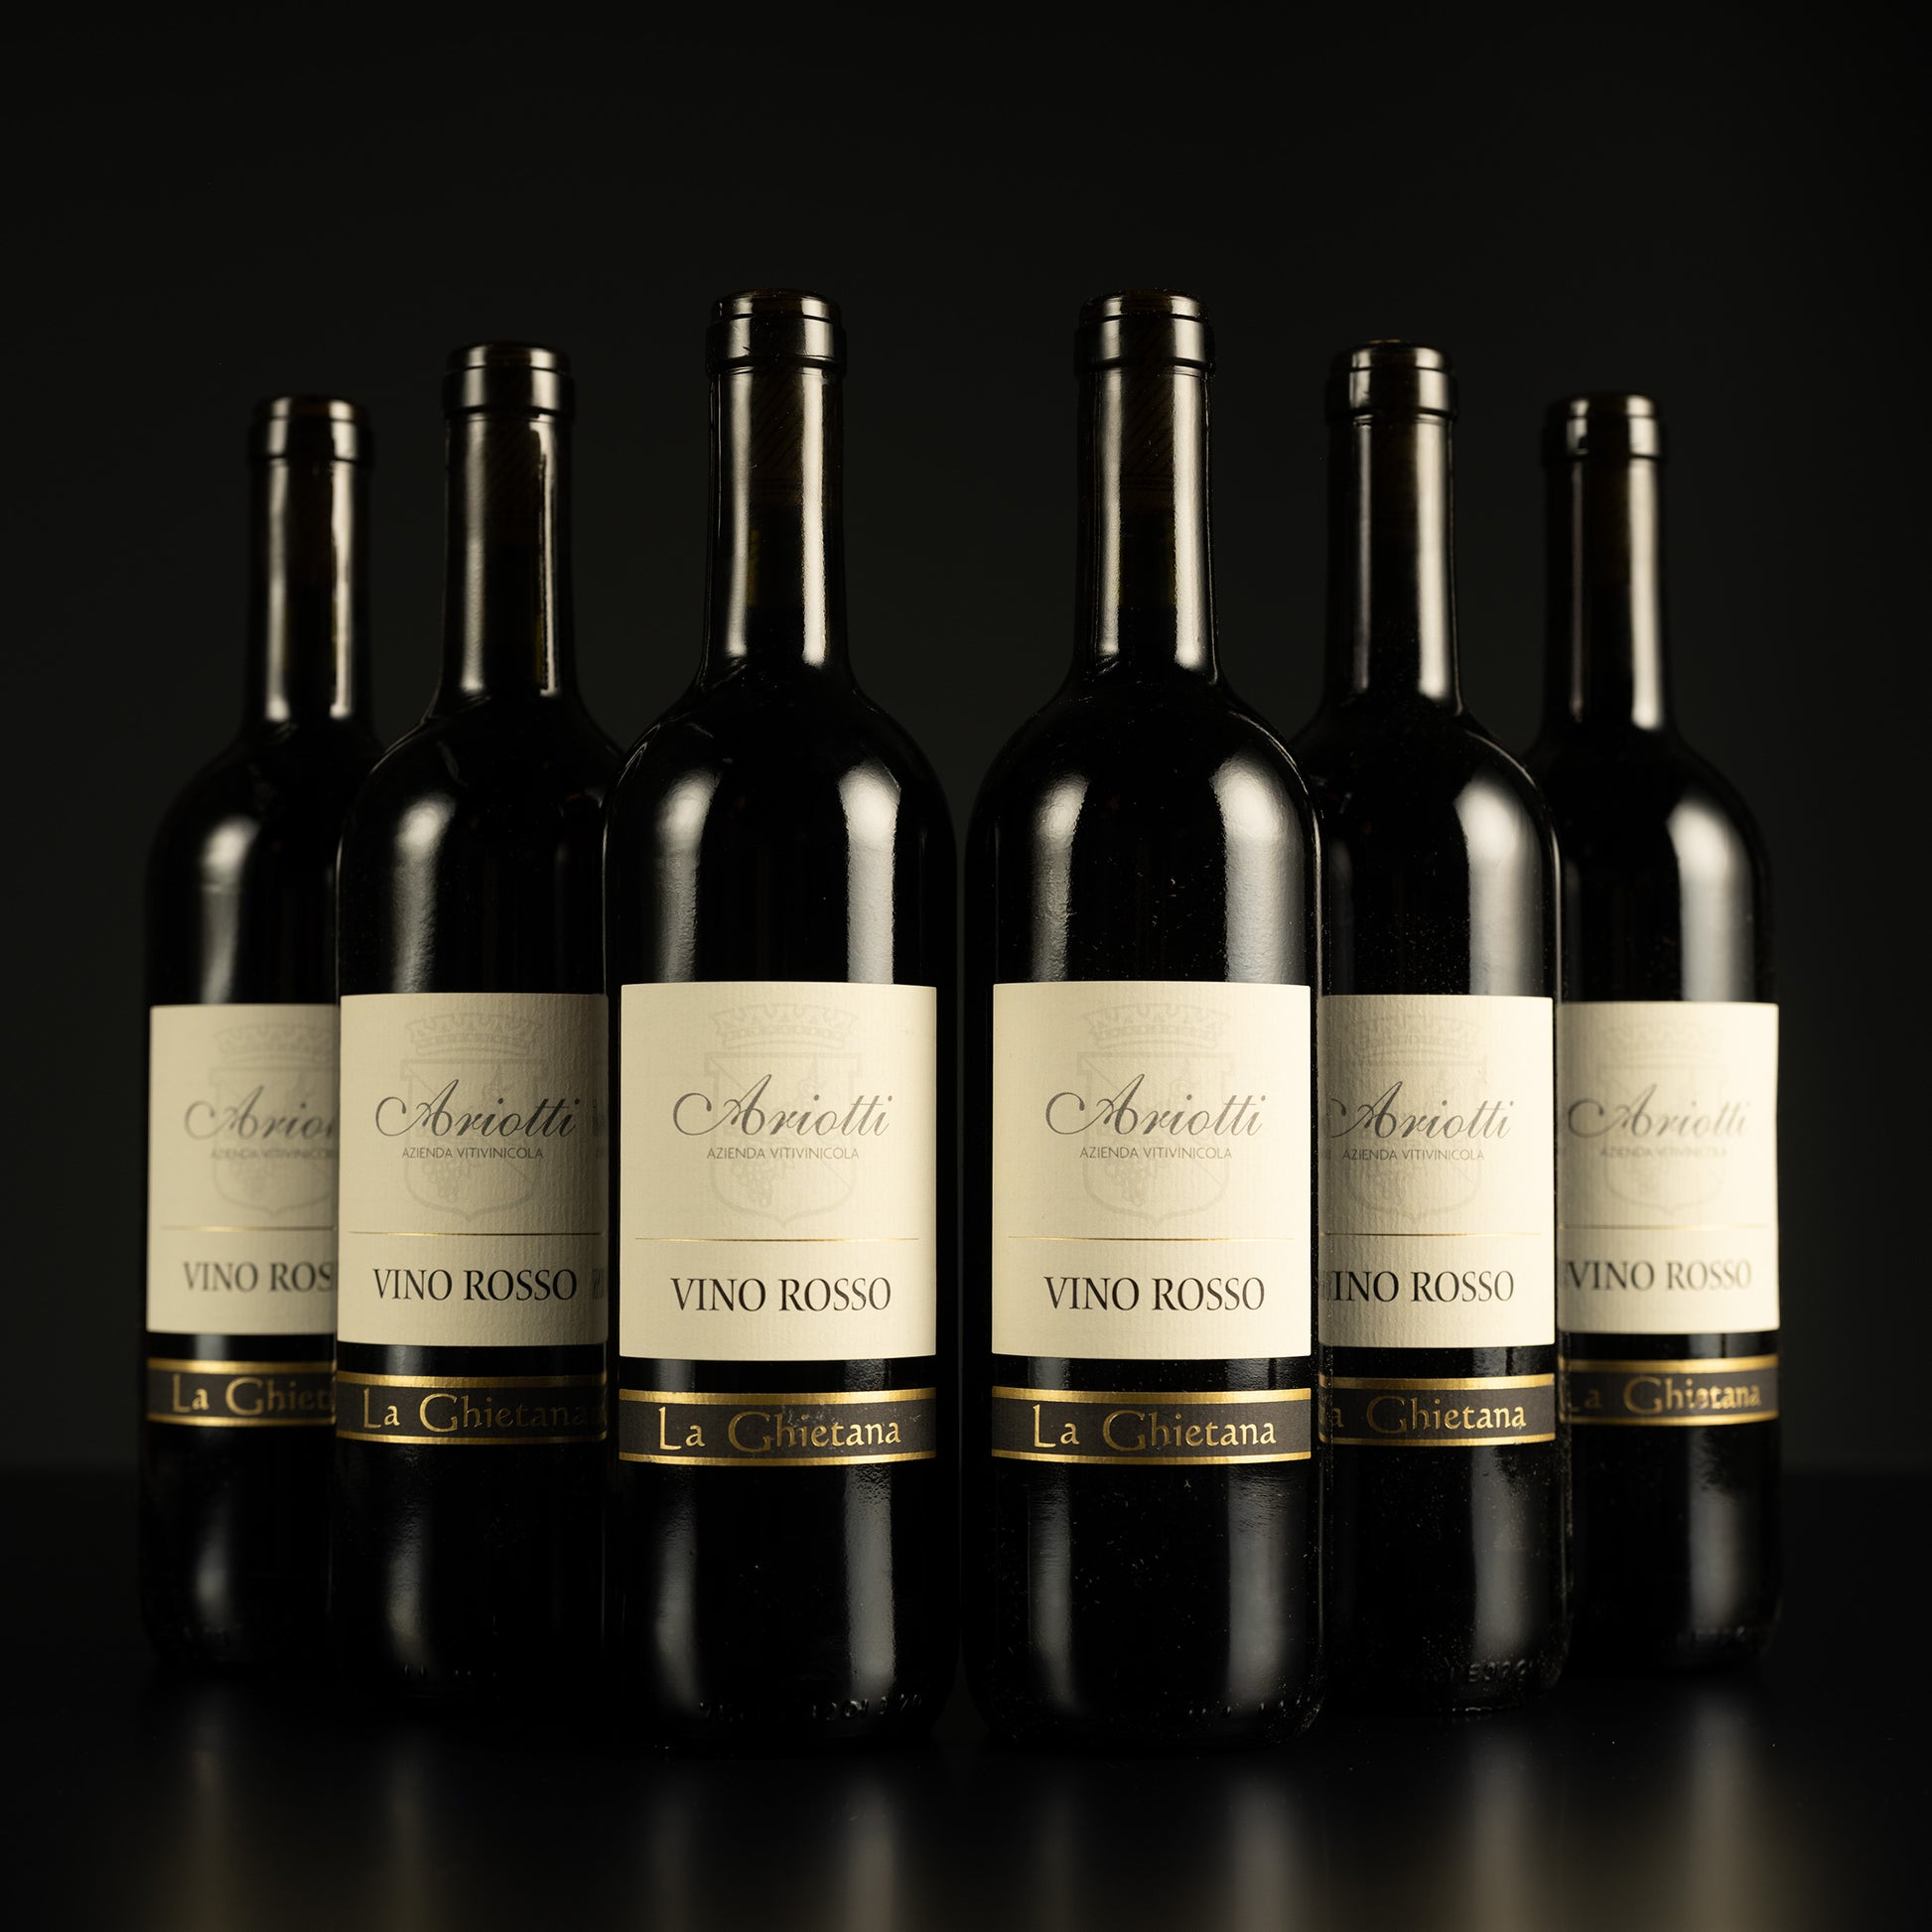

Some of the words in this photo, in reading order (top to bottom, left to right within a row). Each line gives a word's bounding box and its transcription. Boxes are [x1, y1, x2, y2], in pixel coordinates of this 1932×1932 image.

[375, 1078, 580, 1137] Ariotti
[672, 1074, 894, 1136] Ariotti
[1044, 1073, 1266, 1136] Ariotti
[1330, 1080, 1514, 1139] Ariotti
[1568, 1084, 1751, 1139] Ariotti
[402, 1147, 453, 1160] AZIENDA
[458, 1147, 544, 1160] VITIVINICOLA
[707, 1147, 765, 1160] AZIENDA
[770, 1147, 860, 1160] VITIVINICOLA
[1079, 1146, 1139, 1160] AZIENDA
[1144, 1146, 1232, 1160] VITIVINICOLA
[1342, 1149, 1398, 1161] AZIENDA
[1401, 1149, 1485, 1161] VITIVINICOLA
[183, 1260, 258, 1293] VINO
[269, 1260, 337, 1293] ROS
[372, 1268, 453, 1301] VINO
[463, 1268, 578, 1301] ROSSO
[670, 1277, 766, 1311] VINO
[778, 1277, 892, 1311] ROSSO
[1043, 1276, 1140, 1311] VINO
[1152, 1277, 1265, 1311] ROSSO
[1331, 1270, 1399, 1302] INO
[1410, 1270, 1514, 1303] ROSSO
[1567, 1260, 1655, 1292] VINO
[1666, 1260, 1752, 1293] ROSSO
[173, 1373, 209, 1414] La
[225, 1376, 332, 1417] Ghiet
[362, 1388, 400, 1430] La
[419, 1392, 589, 1433] Ghietana
[1331, 1406, 1345, 1428] a
[1366, 1394, 1526, 1435] Ghietana
[1623, 1375, 1761, 1415] Ghietana
[657, 1406, 705, 1451] La
[727, 1410, 901, 1453] Ghietana
[1032, 1404, 1080, 1449] La
[1101, 1409, 1277, 1452] Ghietana
